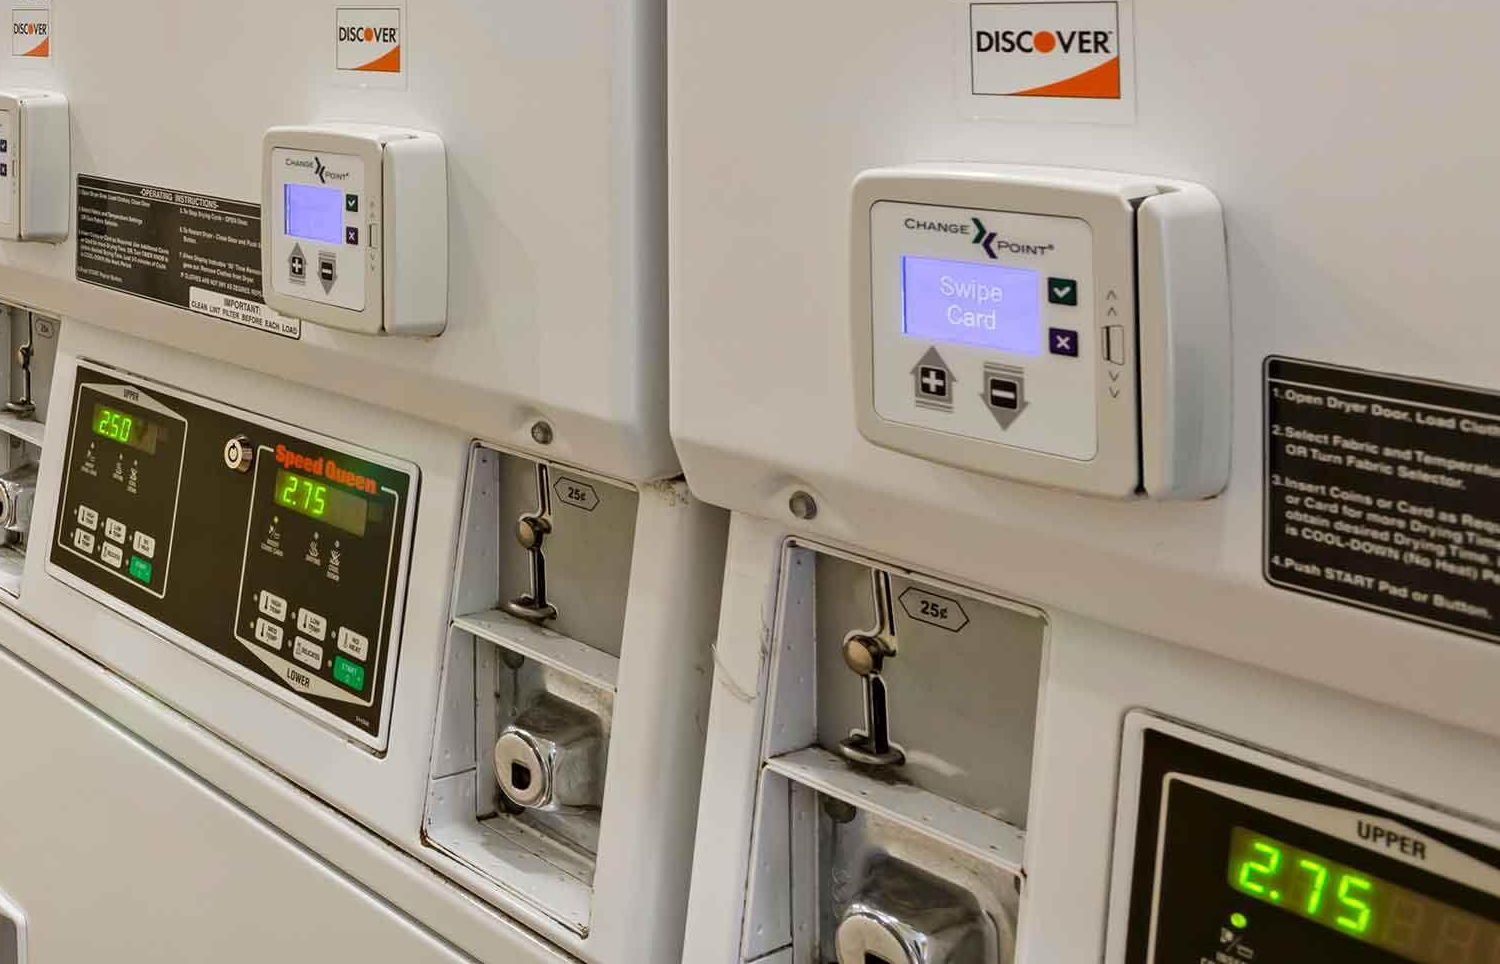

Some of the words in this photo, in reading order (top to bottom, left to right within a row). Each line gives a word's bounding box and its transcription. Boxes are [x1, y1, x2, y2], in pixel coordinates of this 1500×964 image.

[13, 22, 47, 35] DISCOVER
[339, 27, 397, 42] DISCOVER
[976, 30, 1111, 54] DISCOVER
[904, 217, 970, 235] CHANGE
[940, 275, 1003, 304] Swipe
[191, 300, 208, 310] CLEAN
[222, 308, 240, 320] FILTER
[241, 313, 263, 326] BEFORE
[265, 318, 280, 331] EACH
[281, 323, 298, 335] LOAD
[947, 305, 997, 331] Card
[123, 388, 140, 402] UPPER
[1284, 389, 1323, 406] Open
[1326, 396, 1367, 413] Dryer
[1415, 411, 1456, 429] Load
[99, 409, 132, 444] 2.50
[1284, 426, 1329, 444] Select
[1332, 435, 1379, 455] Fabric
[1382, 447, 1412, 461] and
[275, 442, 323, 476] Speed
[325, 458, 377, 495] Queen
[1285, 443, 1308, 458] OR
[1309, 447, 1343, 465] Turn
[1346, 455, 1394, 475] Fabric
[283, 475, 327, 515] 2.75
[1329, 486, 1373, 506] Coins
[1376, 498, 1393, 509] or
[1397, 500, 1434, 519] Card
[1437, 511, 1458, 524] as
[1285, 495, 1300, 506] or
[1304, 497, 1339, 514] Card
[1341, 504, 1363, 518] for
[1365, 512, 1406, 529] more
[1409, 519, 1463, 544] Drying
[1285, 510, 1331, 527] obtain
[1333, 520, 1390, 542] desired
[1393, 532, 1446, 557] Drying
[1301, 527, 1400, 561] COOL-DOWN
[1284, 557, 1321, 576] Push
[1324, 567, 1375, 589] START
[920, 599, 949, 620] 25¢
[286, 667, 310, 688] LOWER
[1357, 819, 1427, 860] UPPER
[1238, 841, 1372, 933] 2.75
